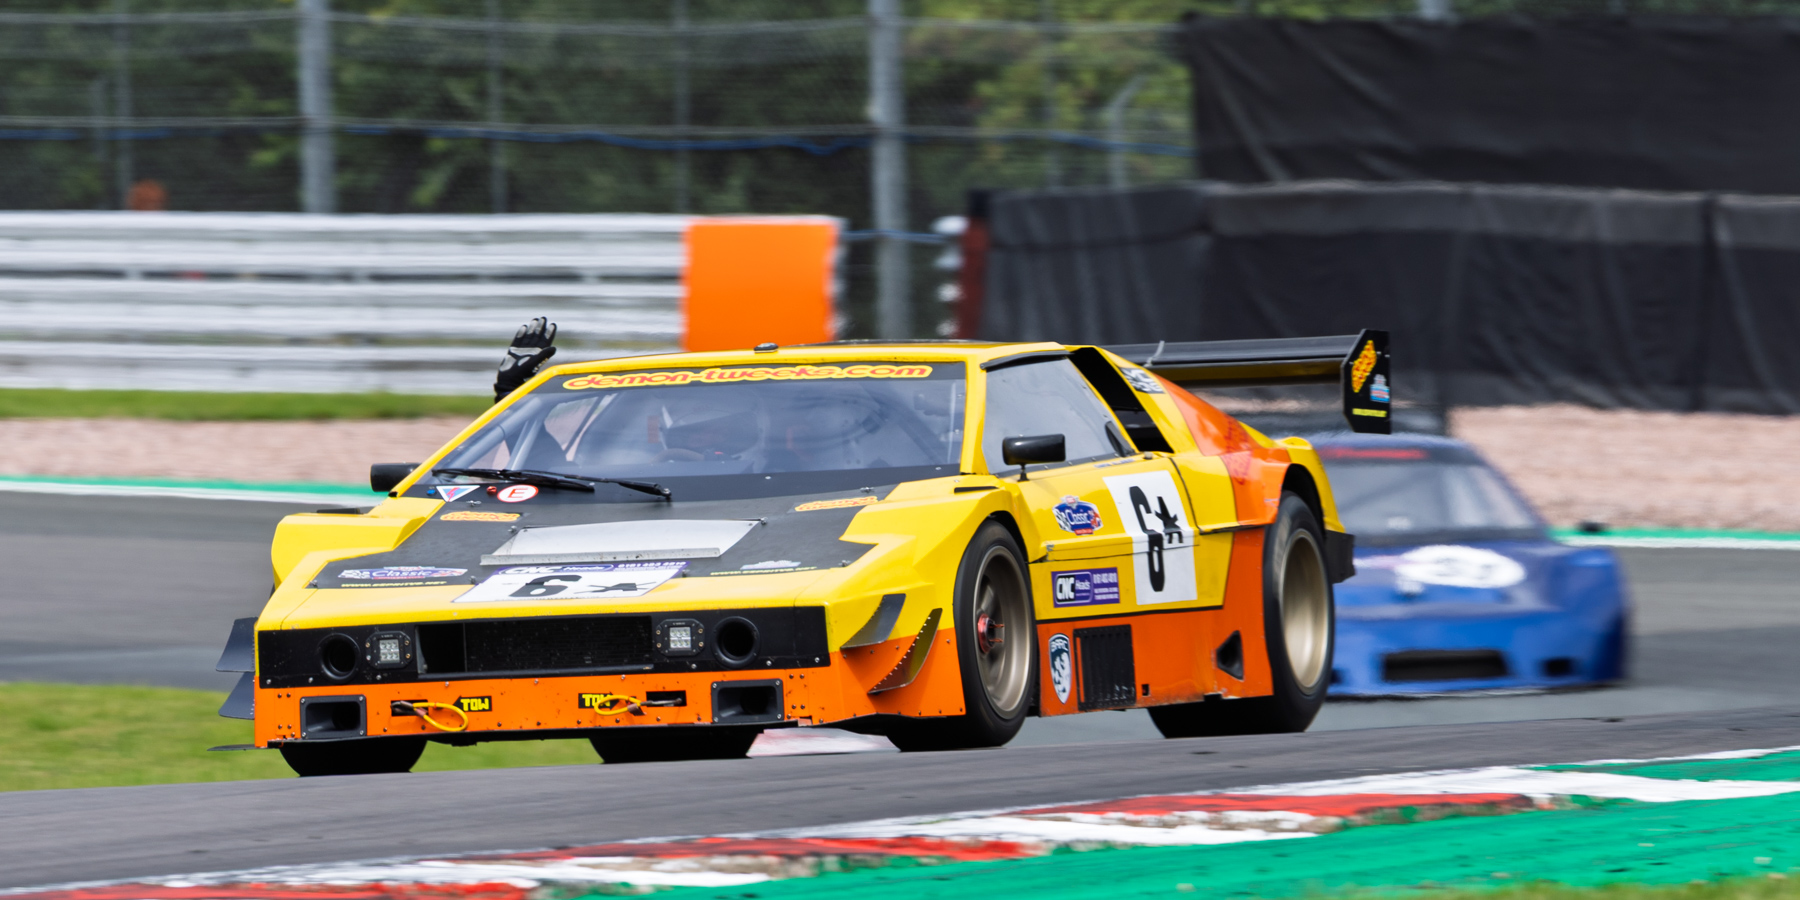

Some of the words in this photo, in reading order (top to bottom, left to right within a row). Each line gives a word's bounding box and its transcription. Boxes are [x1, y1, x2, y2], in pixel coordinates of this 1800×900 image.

[562, 365, 932, 390] demon-tweeks.com
[507, 487, 529, 499] E
[1129, 485, 1165, 592] 6
[508, 574, 582, 597] 6
[1057, 577, 1075, 600] CNC
[460, 698, 490, 712] TOW
